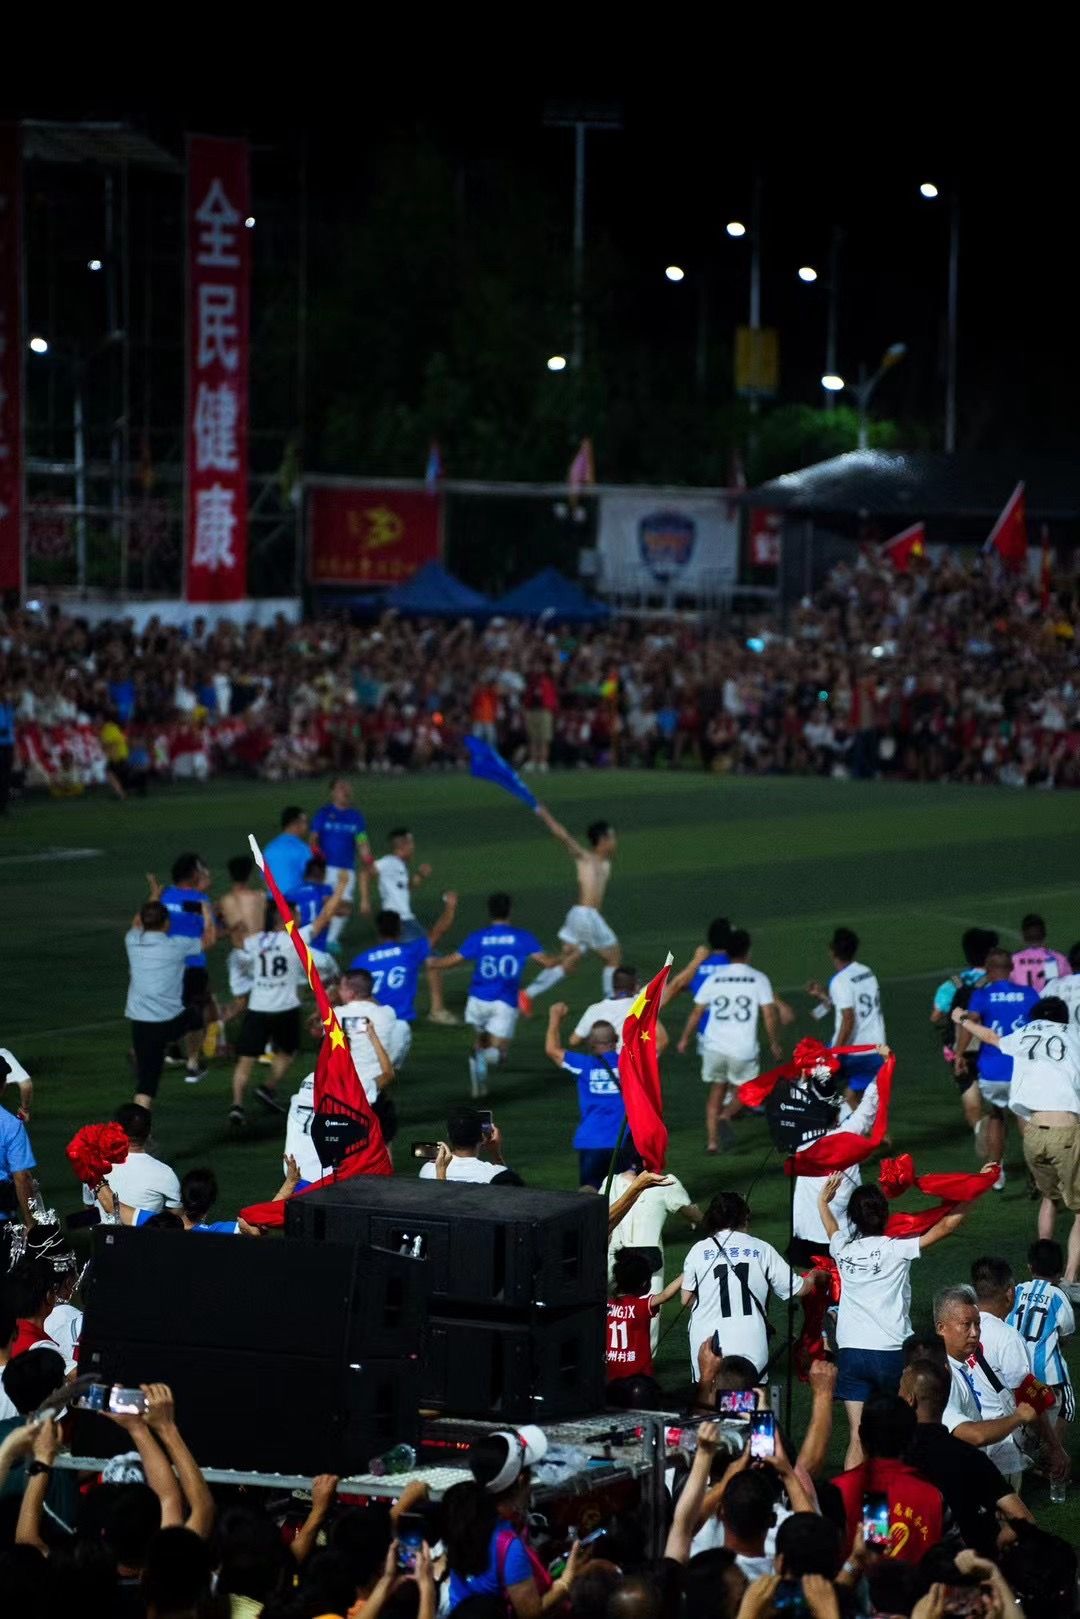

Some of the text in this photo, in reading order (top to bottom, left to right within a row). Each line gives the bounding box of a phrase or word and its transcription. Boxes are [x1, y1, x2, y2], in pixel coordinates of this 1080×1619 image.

[194, 177, 240, 572] 全民健康
[259, 952, 288, 977] 18
[480, 954, 518, 979] 60
[371, 966, 407, 994] 76
[714, 995, 751, 1021] 23
[1020, 1034, 1065, 1061] 70
[713, 1262, 752, 1318] 11
[1020, 1292, 1051, 1305] MESSI
[608, 1320, 628, 1350] 11
[1015, 1304, 1048, 1342] 10
[605, 1350, 636, 1363] 州村超
